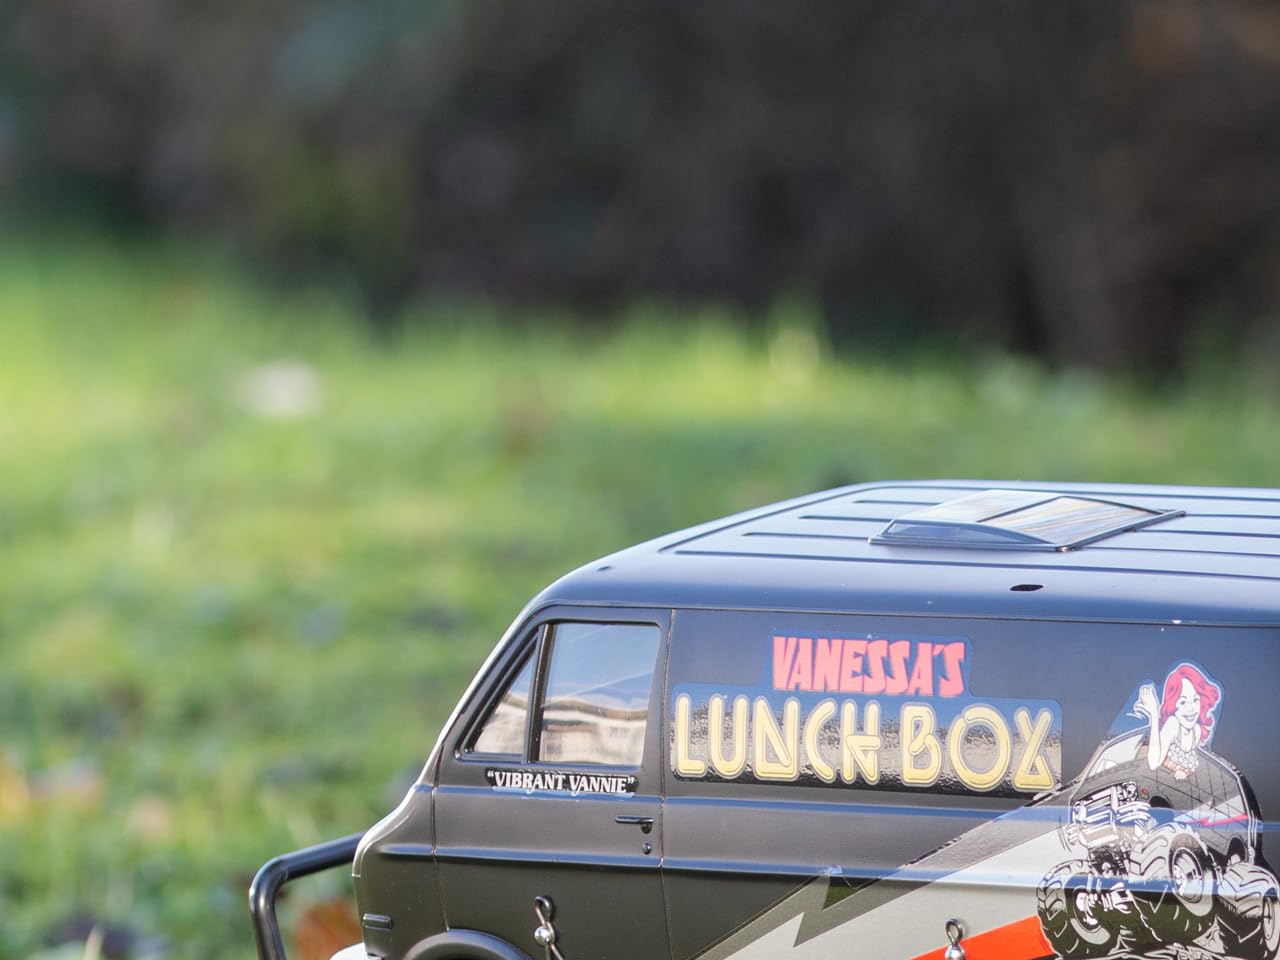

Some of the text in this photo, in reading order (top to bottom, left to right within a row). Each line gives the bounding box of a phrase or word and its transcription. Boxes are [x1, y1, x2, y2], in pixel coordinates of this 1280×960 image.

[772, 635, 966, 698] VANESSA'S
[674, 694, 1055, 792] LUNCH BOX
